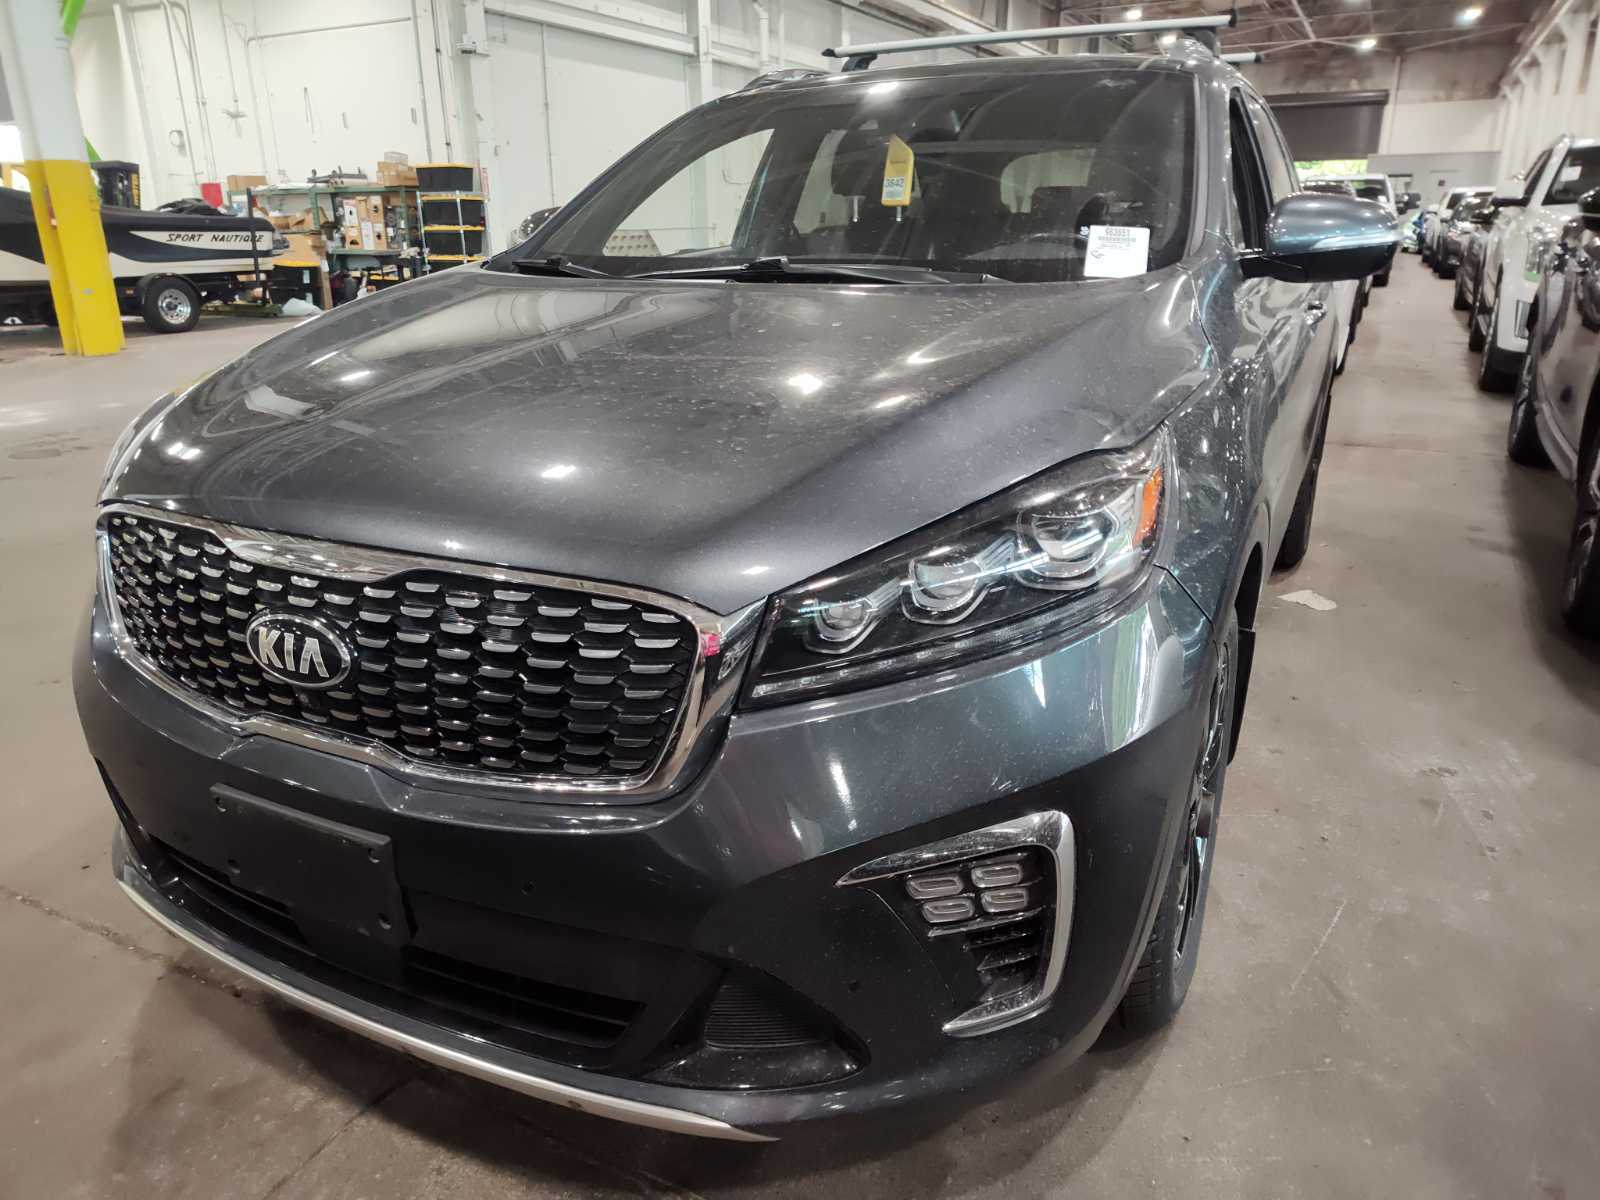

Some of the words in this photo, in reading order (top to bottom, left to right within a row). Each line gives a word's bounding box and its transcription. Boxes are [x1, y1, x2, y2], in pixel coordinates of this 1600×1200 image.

[166, 233, 204, 242] SPORT
[210, 234, 265, 243] NAUTIQE
[258, 626, 330, 678] KIA
